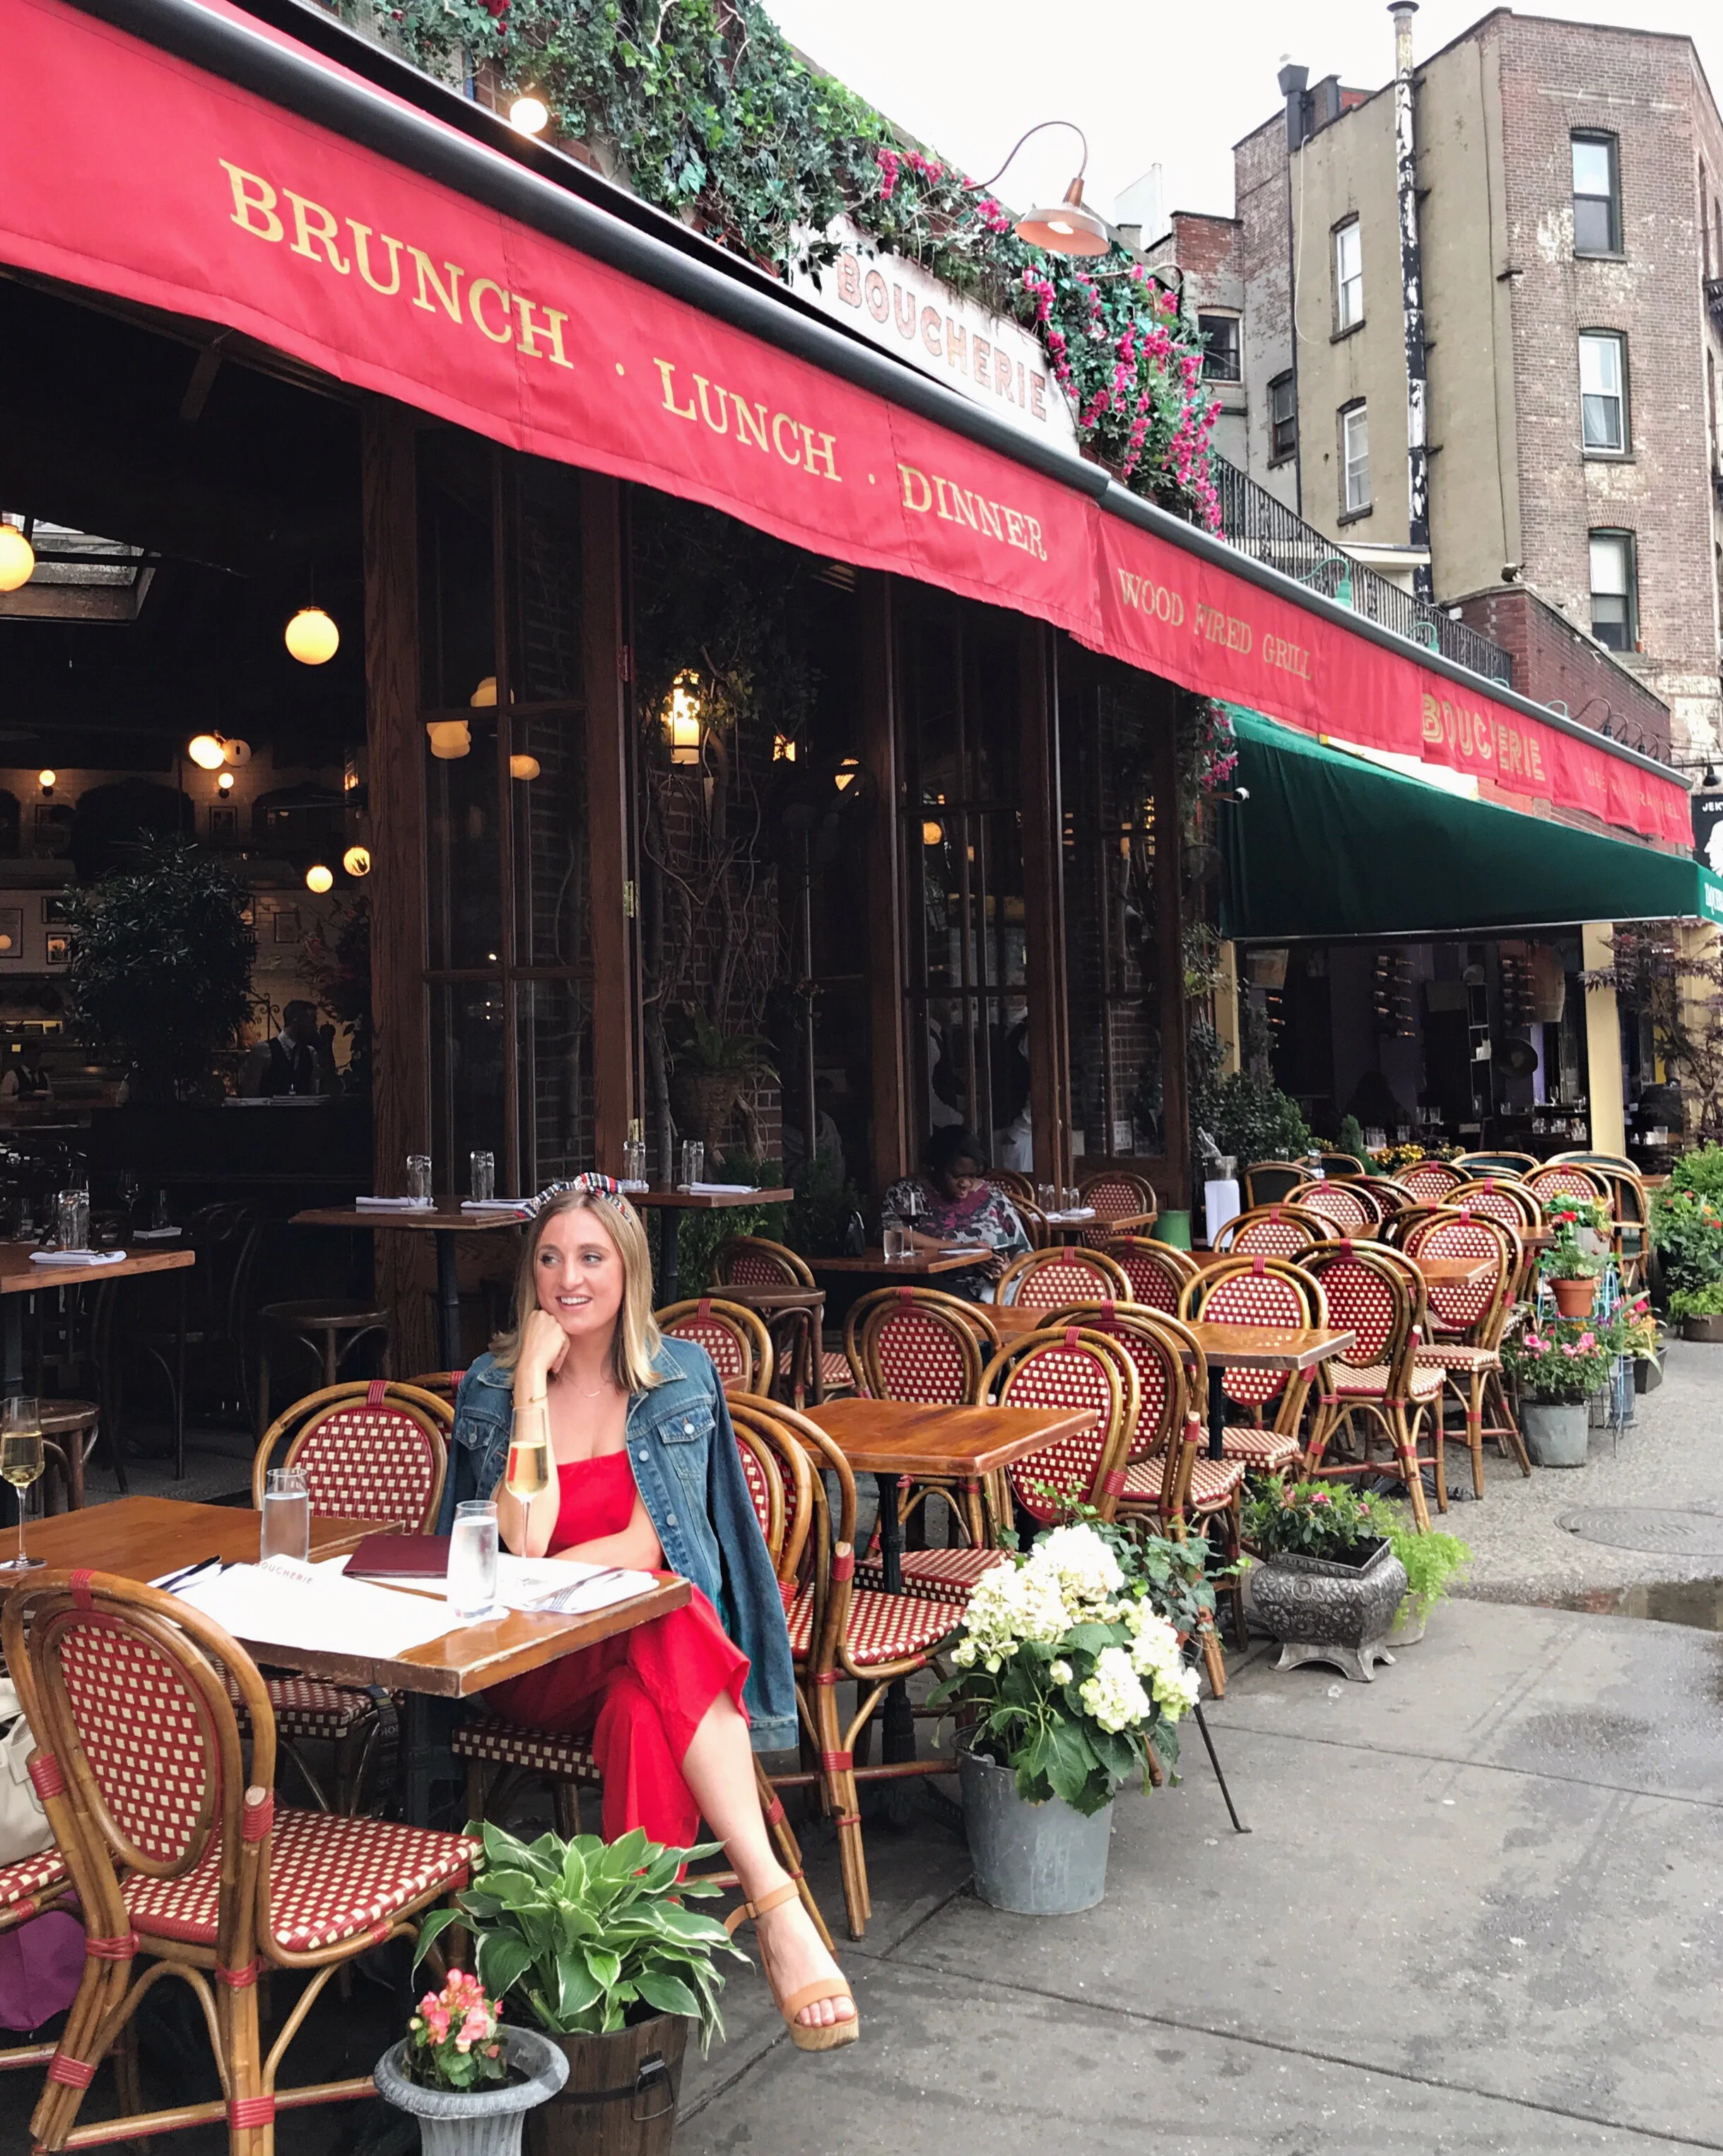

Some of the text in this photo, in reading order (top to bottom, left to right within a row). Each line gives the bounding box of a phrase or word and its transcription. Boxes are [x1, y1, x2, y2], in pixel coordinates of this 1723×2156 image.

[218, 158, 1048, 562] BRUNCH LUNCH DINNER
[837, 252, 1047, 423] BOUCHERIE
[1117, 567, 1312, 681] WOOD FIRED GRILL
